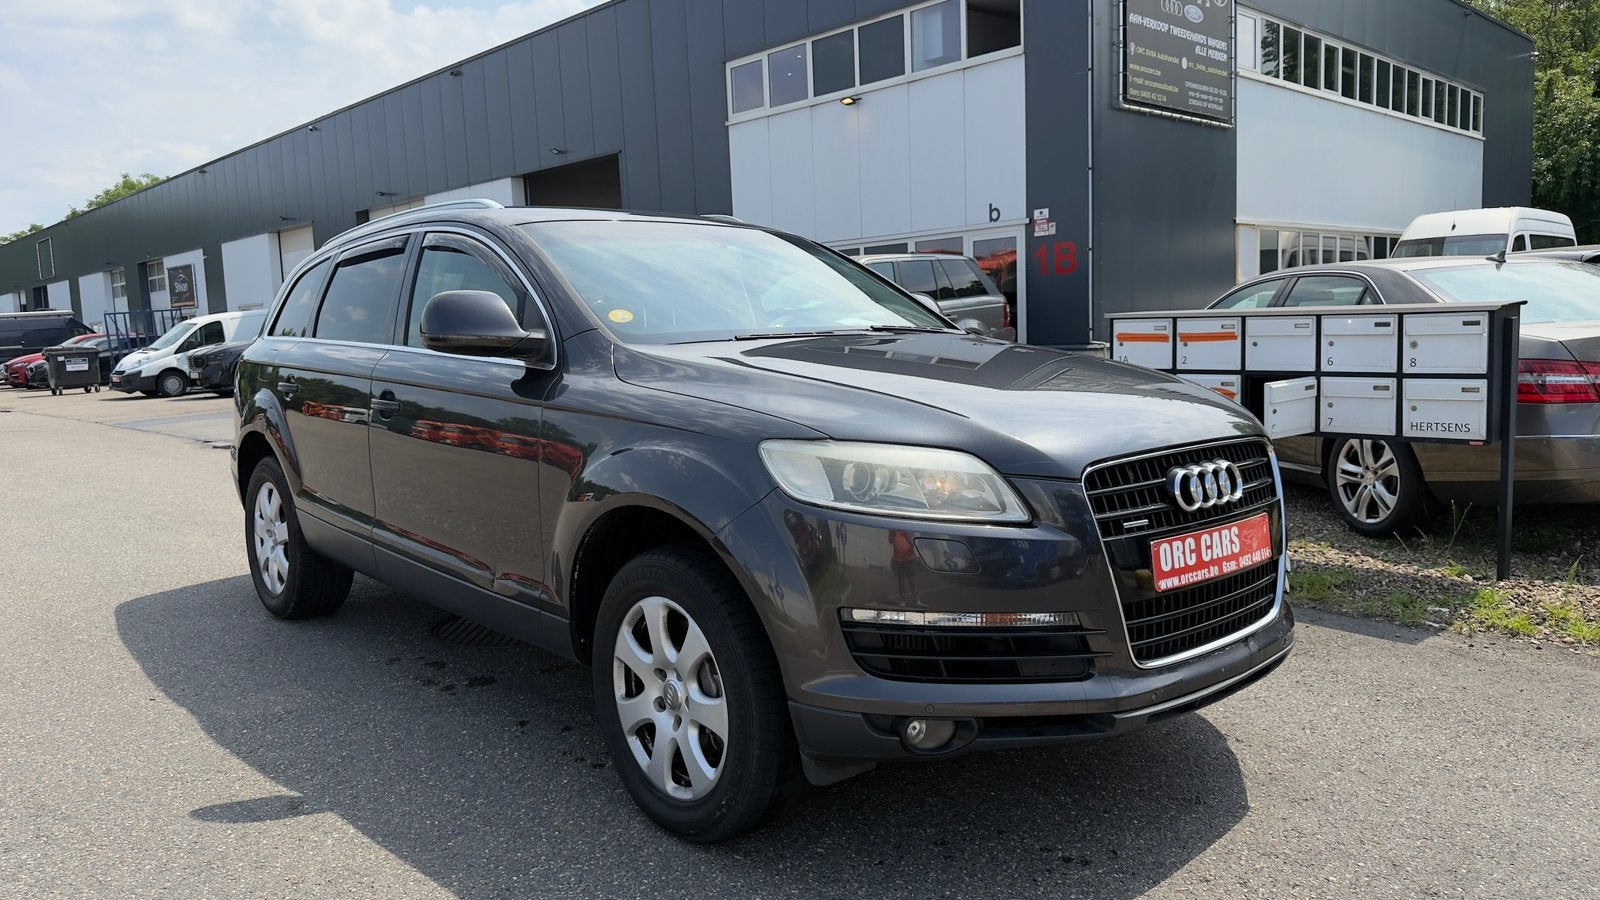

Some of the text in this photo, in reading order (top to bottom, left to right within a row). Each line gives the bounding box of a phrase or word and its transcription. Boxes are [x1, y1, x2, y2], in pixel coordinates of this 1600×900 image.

[1129, 13, 1228, 51] AAN-VERKOOP TWEEDEHANDS WAGENS
[1136, 46, 1146, 55] ORC
[1157, 52, 1179, 64] Autohandel
[1195, 45, 1228, 62] ALLE MERKEN
[989, 203, 1001, 222] b
[1035, 242, 1078, 276] 1B
[1182, 356, 1188, 365] 2
[1327, 357, 1334, 366] 6
[1410, 357, 1417, 367] 8
[1328, 418, 1333, 426] 7
[1410, 422, 1471, 433] HERTSENS
[1160, 526, 1240, 572] ORC CARS
[1160, 565, 1219, 590] www.orccars.be
[1222, 560, 1238, 573] Gsm:
